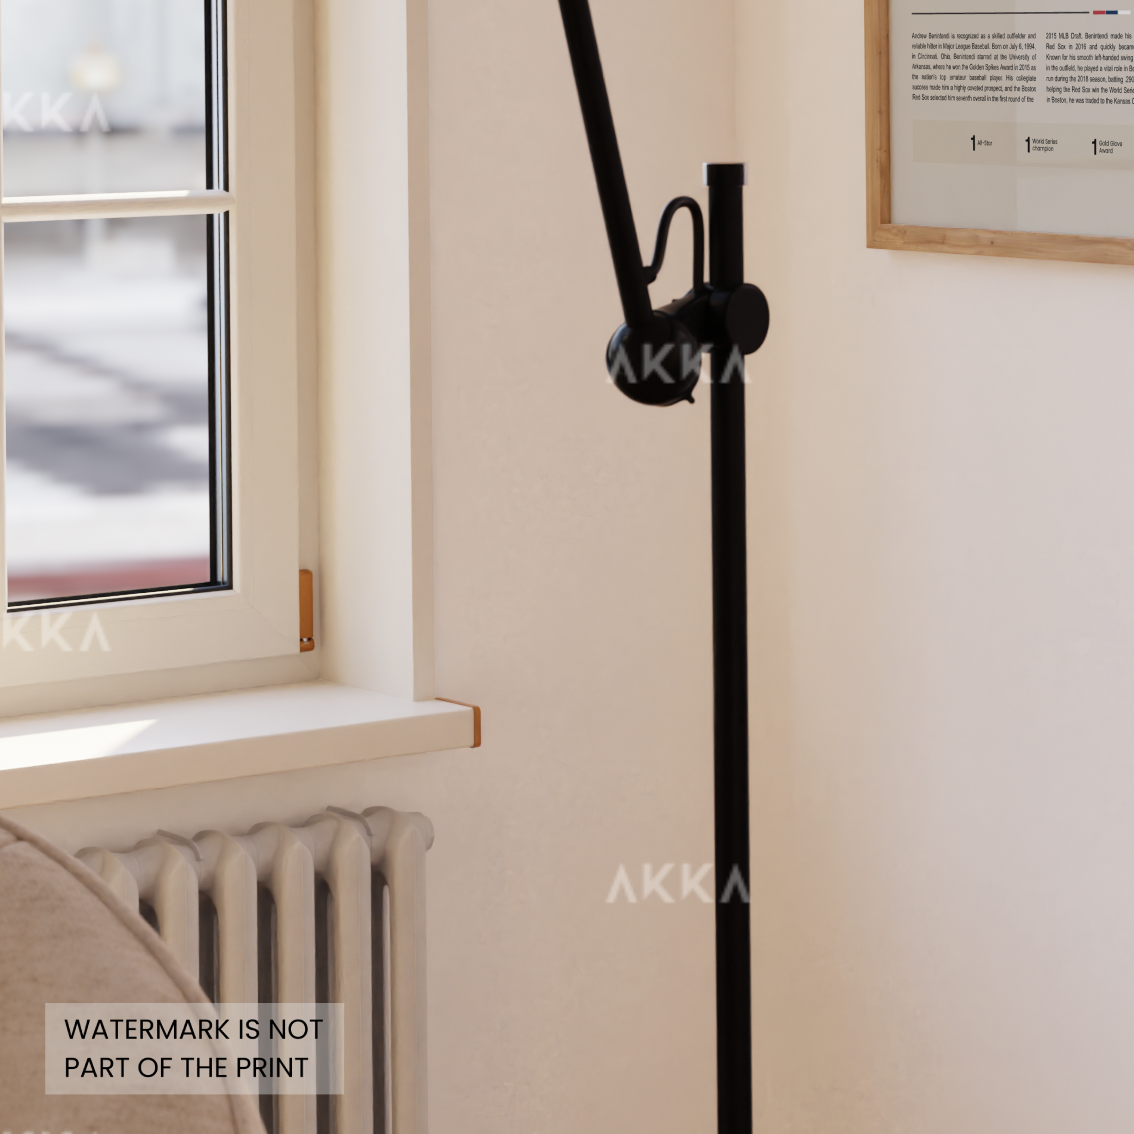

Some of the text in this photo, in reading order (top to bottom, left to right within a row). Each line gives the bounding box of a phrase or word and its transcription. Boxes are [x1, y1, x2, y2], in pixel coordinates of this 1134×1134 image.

[1058, 31, 1069, 39] MLB
[1045, 42, 1055, 50] Red
[1057, 42, 1066, 50] Sox
[1088, 42, 1098, 50] and
[1099, 42, 1116, 51] quickly
[970, 135, 975, 151] 1
[1025, 136, 1030, 153] 1
[1091, 138, 1097, 155] 1
